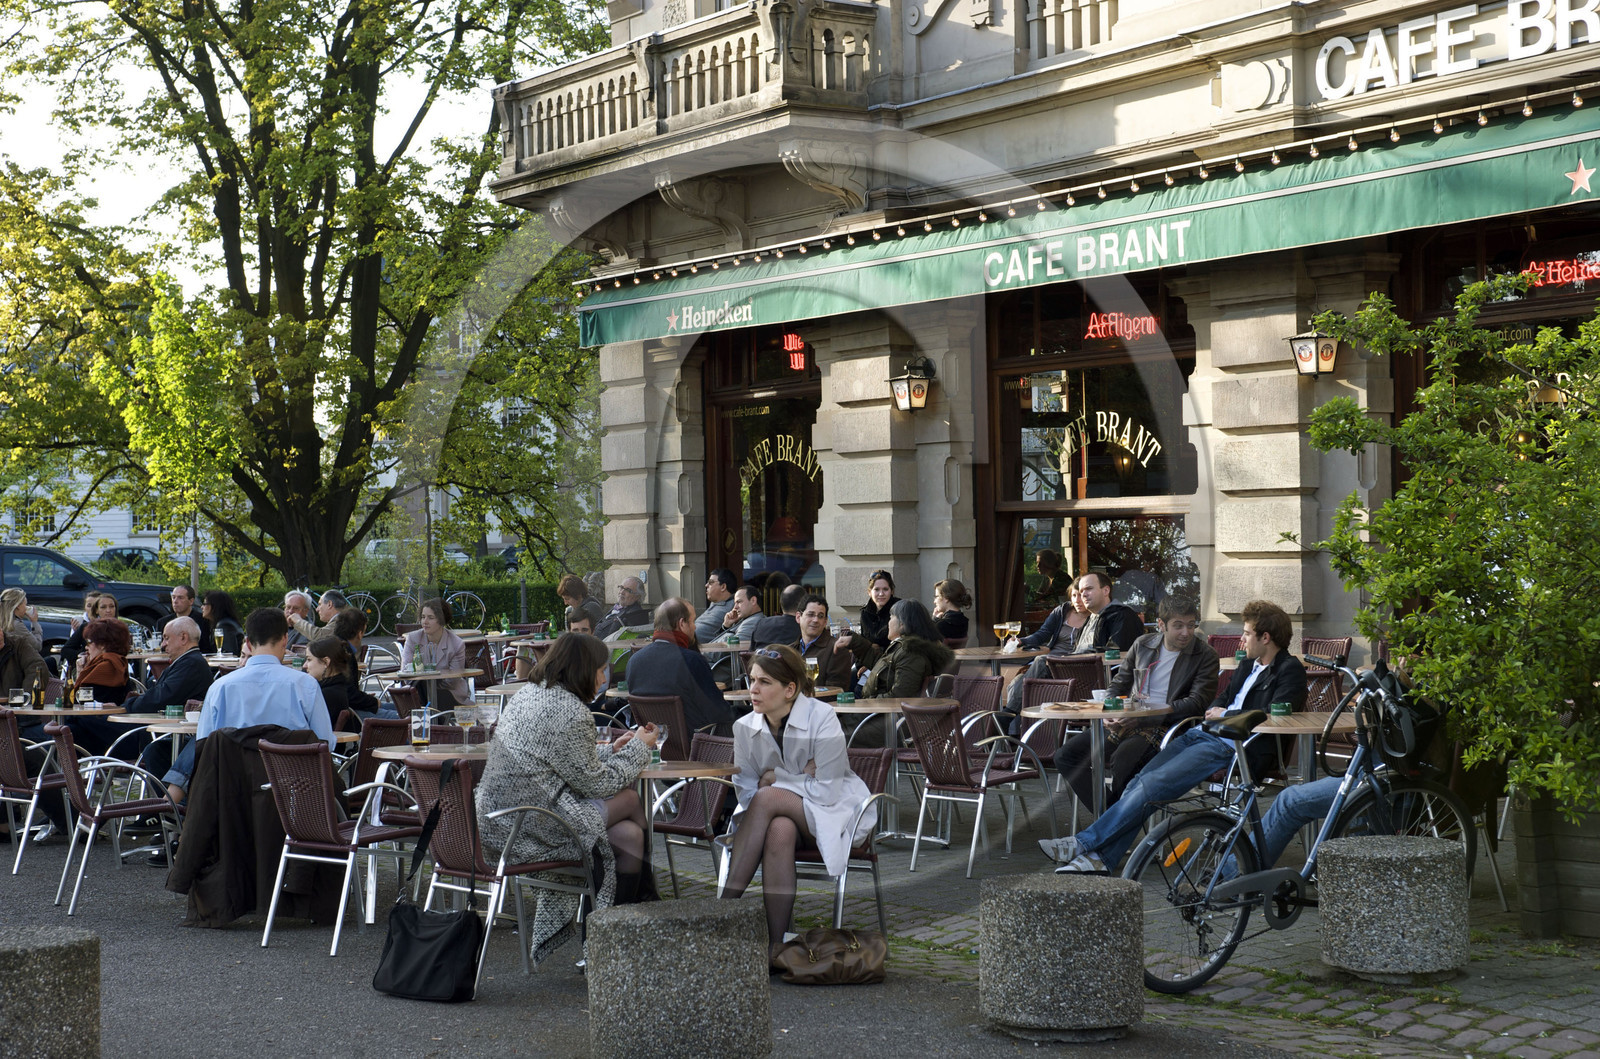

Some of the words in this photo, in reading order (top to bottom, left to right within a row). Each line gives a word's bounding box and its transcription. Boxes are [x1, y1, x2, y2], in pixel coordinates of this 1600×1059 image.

[1315, 4, 1480, 101] CAFE
[984, 240, 1065, 287] CAFE
[1077, 220, 1192, 273] BRANT
[681, 300, 754, 330] Heineken
[1084, 312, 1157, 341] Affligem
[739, 438, 774, 487] CAFE
[776, 434, 823, 482] BRANT
[1096, 411, 1162, 469] BRANT
